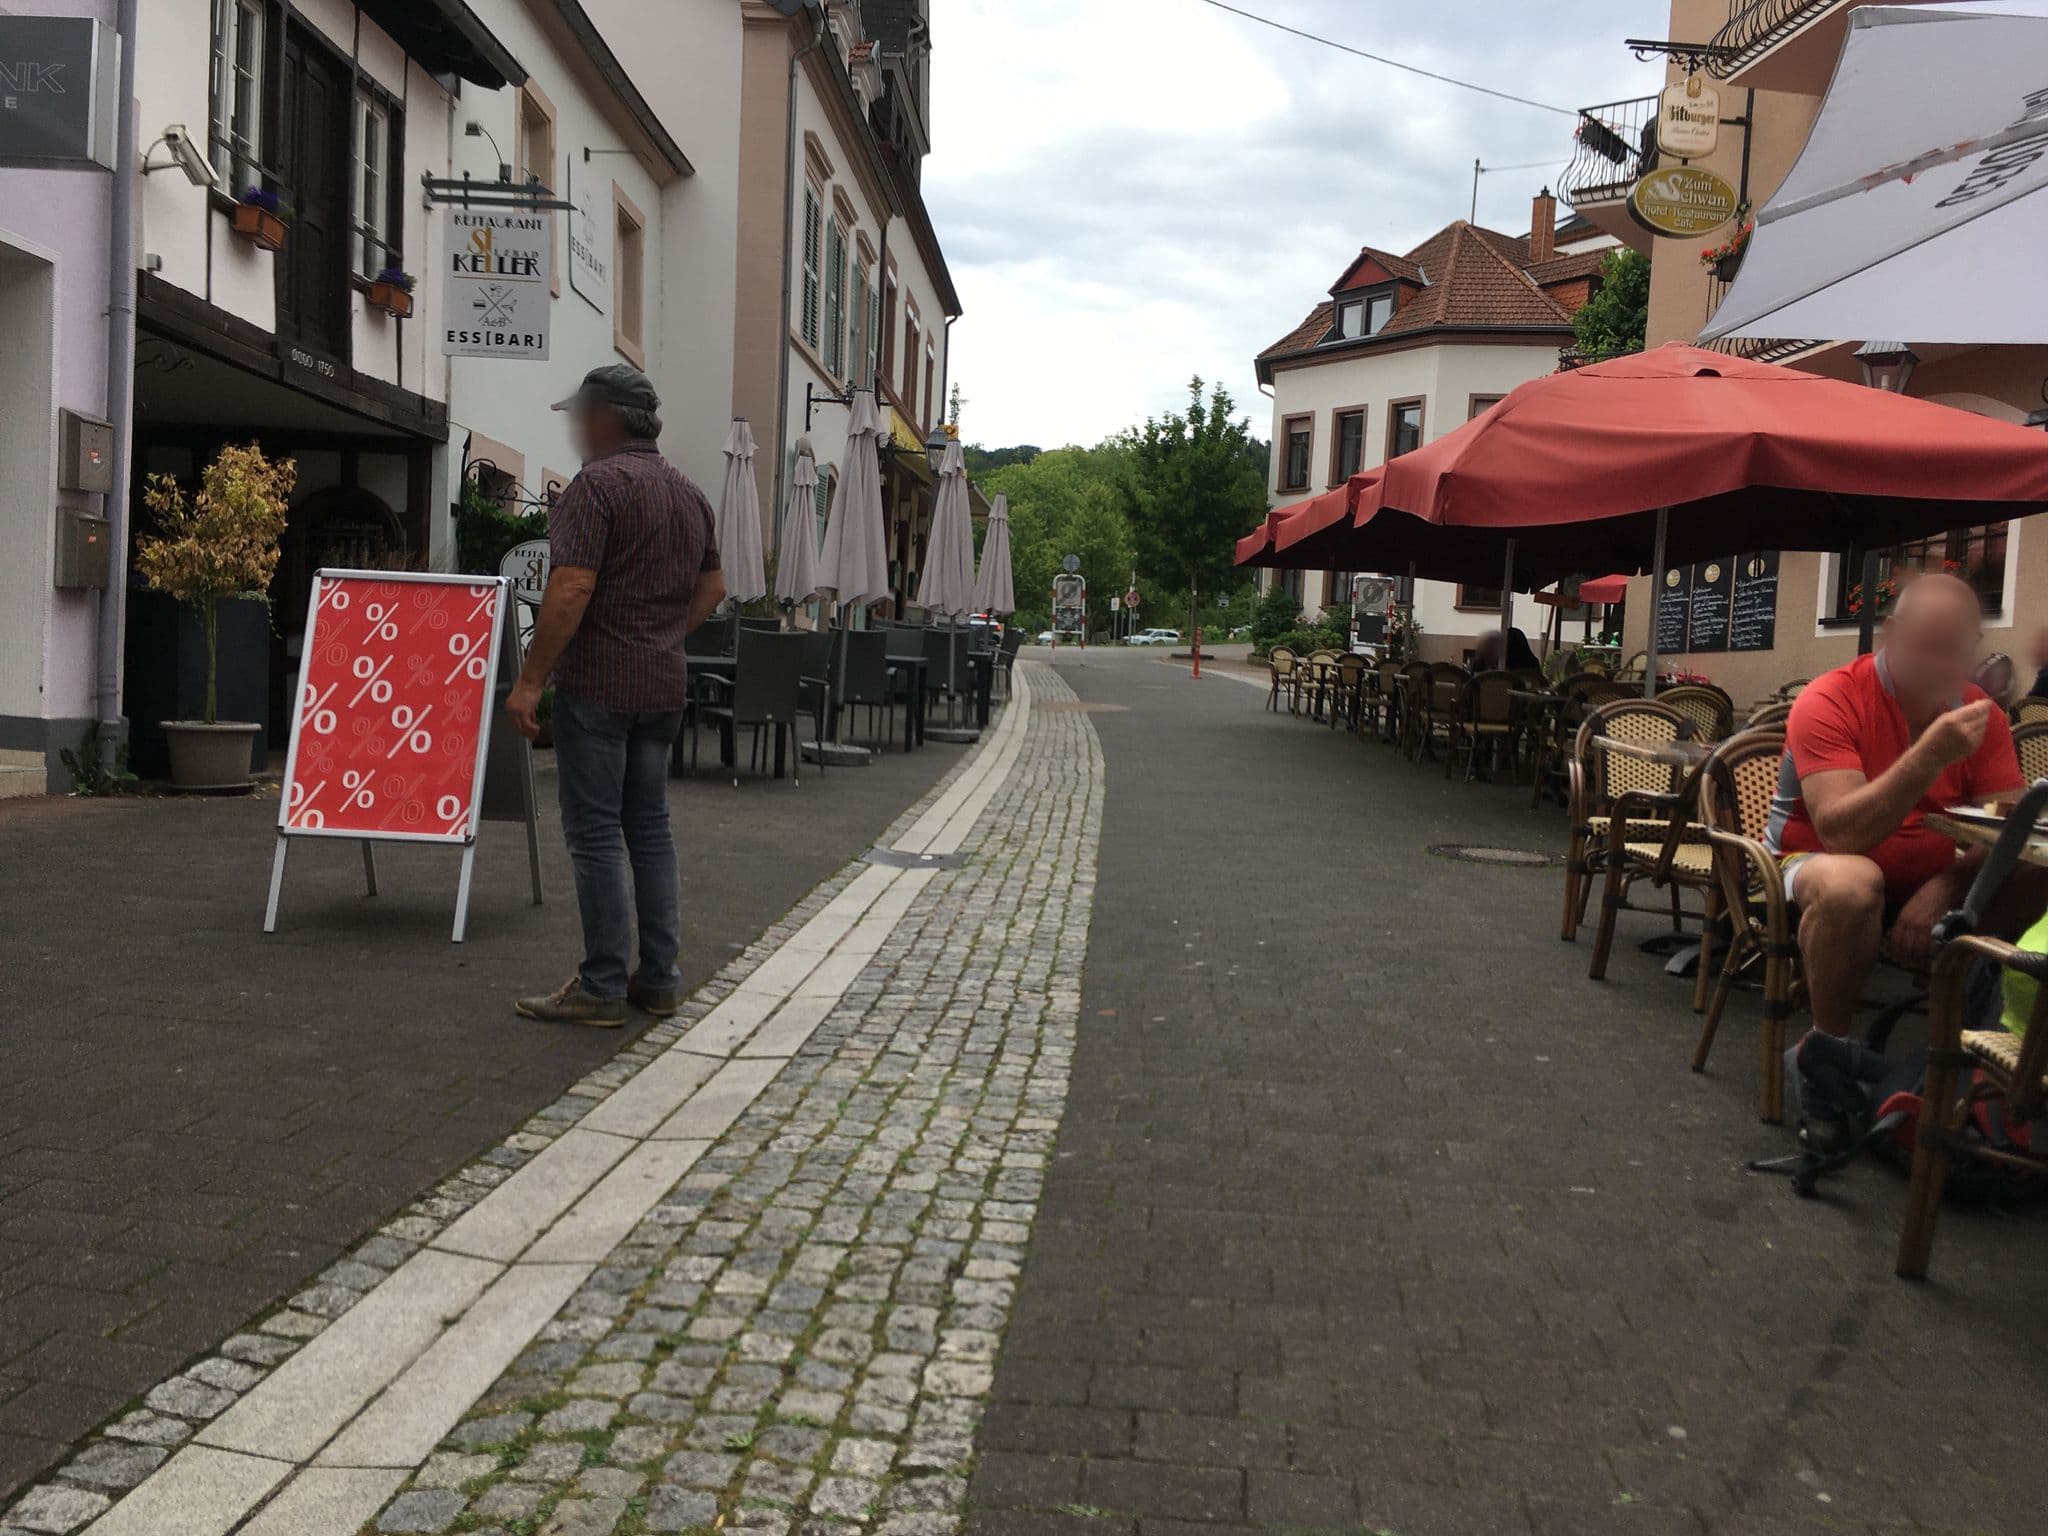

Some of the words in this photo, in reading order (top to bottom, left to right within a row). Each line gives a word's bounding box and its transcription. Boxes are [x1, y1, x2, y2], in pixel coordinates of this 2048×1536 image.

[0, 61, 66, 93] NK
[5, 96, 17, 109] E
[454, 214, 541, 230] RESTAURANT
[1644, 204, 1668, 216] Hotel
[1674, 207, 1726, 222] Restaurant
[453, 253, 541, 277] KELLER
[446, 330, 544, 349] ESS[BAR]
